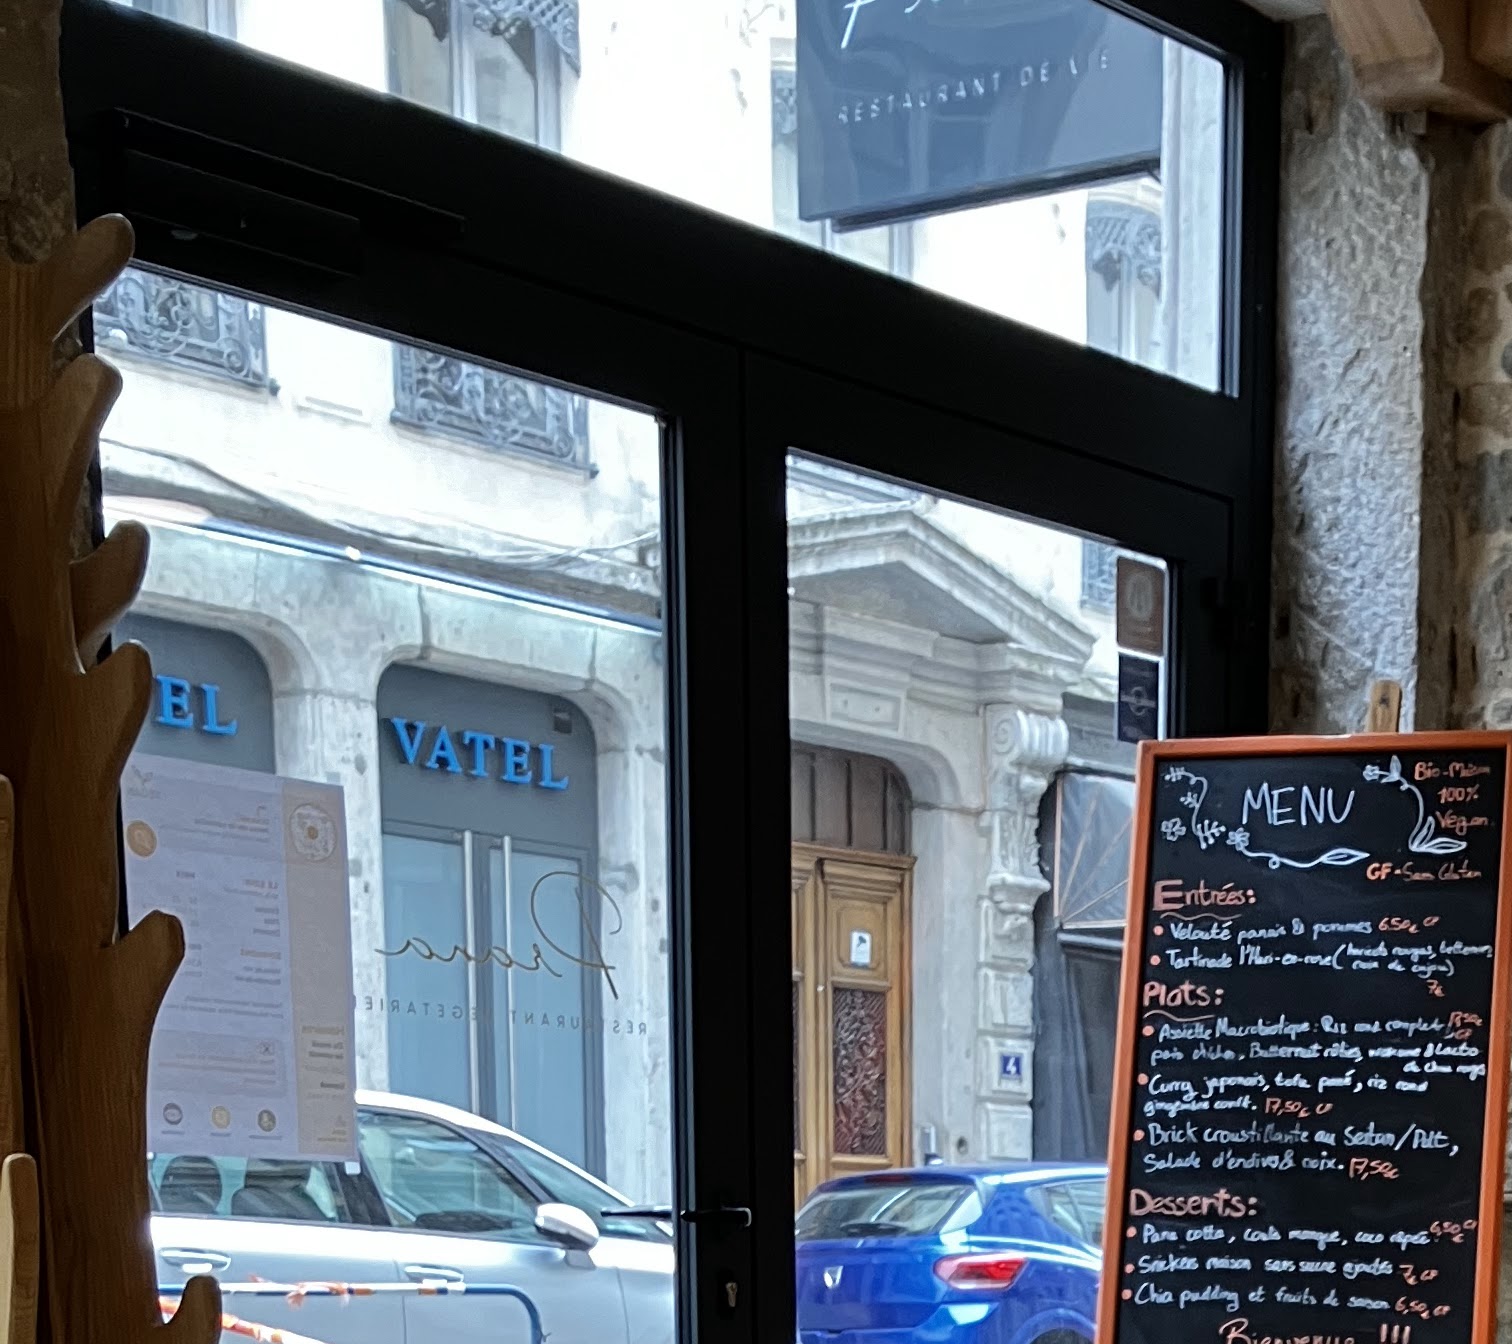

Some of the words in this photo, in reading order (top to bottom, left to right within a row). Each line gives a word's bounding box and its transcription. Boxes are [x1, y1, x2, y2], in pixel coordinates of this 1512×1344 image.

[838, 71, 1000, 124] RESTAURANT
[392, 717, 570, 790] VATEL
[1242, 781, 1355, 827] MENU
[1437, 784, 1479, 804] 100%
[1170, 921, 1233, 940] Velouté
[1312, 921, 1372, 940] pommes
[1165, 947, 1233, 969] Tartinade
[1143, 980, 1224, 1007] Plats:
[1159, 1023, 1213, 1043] Assiette
[1320, 1015, 1347, 1034] Riz
[1151, 1047, 1184, 1066] pois
[1149, 1074, 1199, 1101] Curry
[1367, 1073, 1387, 1090] riz
[1148, 1121, 1198, 1146] Brick
[1203, 1120, 1309, 1144] croustillante
[1314, 1130, 1336, 1145] au
[1143, 1151, 1200, 1173] Salade
[1129, 1187, 1259, 1218] Desserts:
[1355, 1231, 1384, 1243] coco
[1205, 1255, 1252, 1270] maison
[1264, 1259, 1296, 1272] sans
[1135, 1282, 1173, 1304] Chia
[1179, 1284, 1240, 1313] pudding
[1249, 1286, 1265, 1302] et
[1275, 1286, 1317, 1304] fruits
[1323, 1288, 1340, 1306] de
